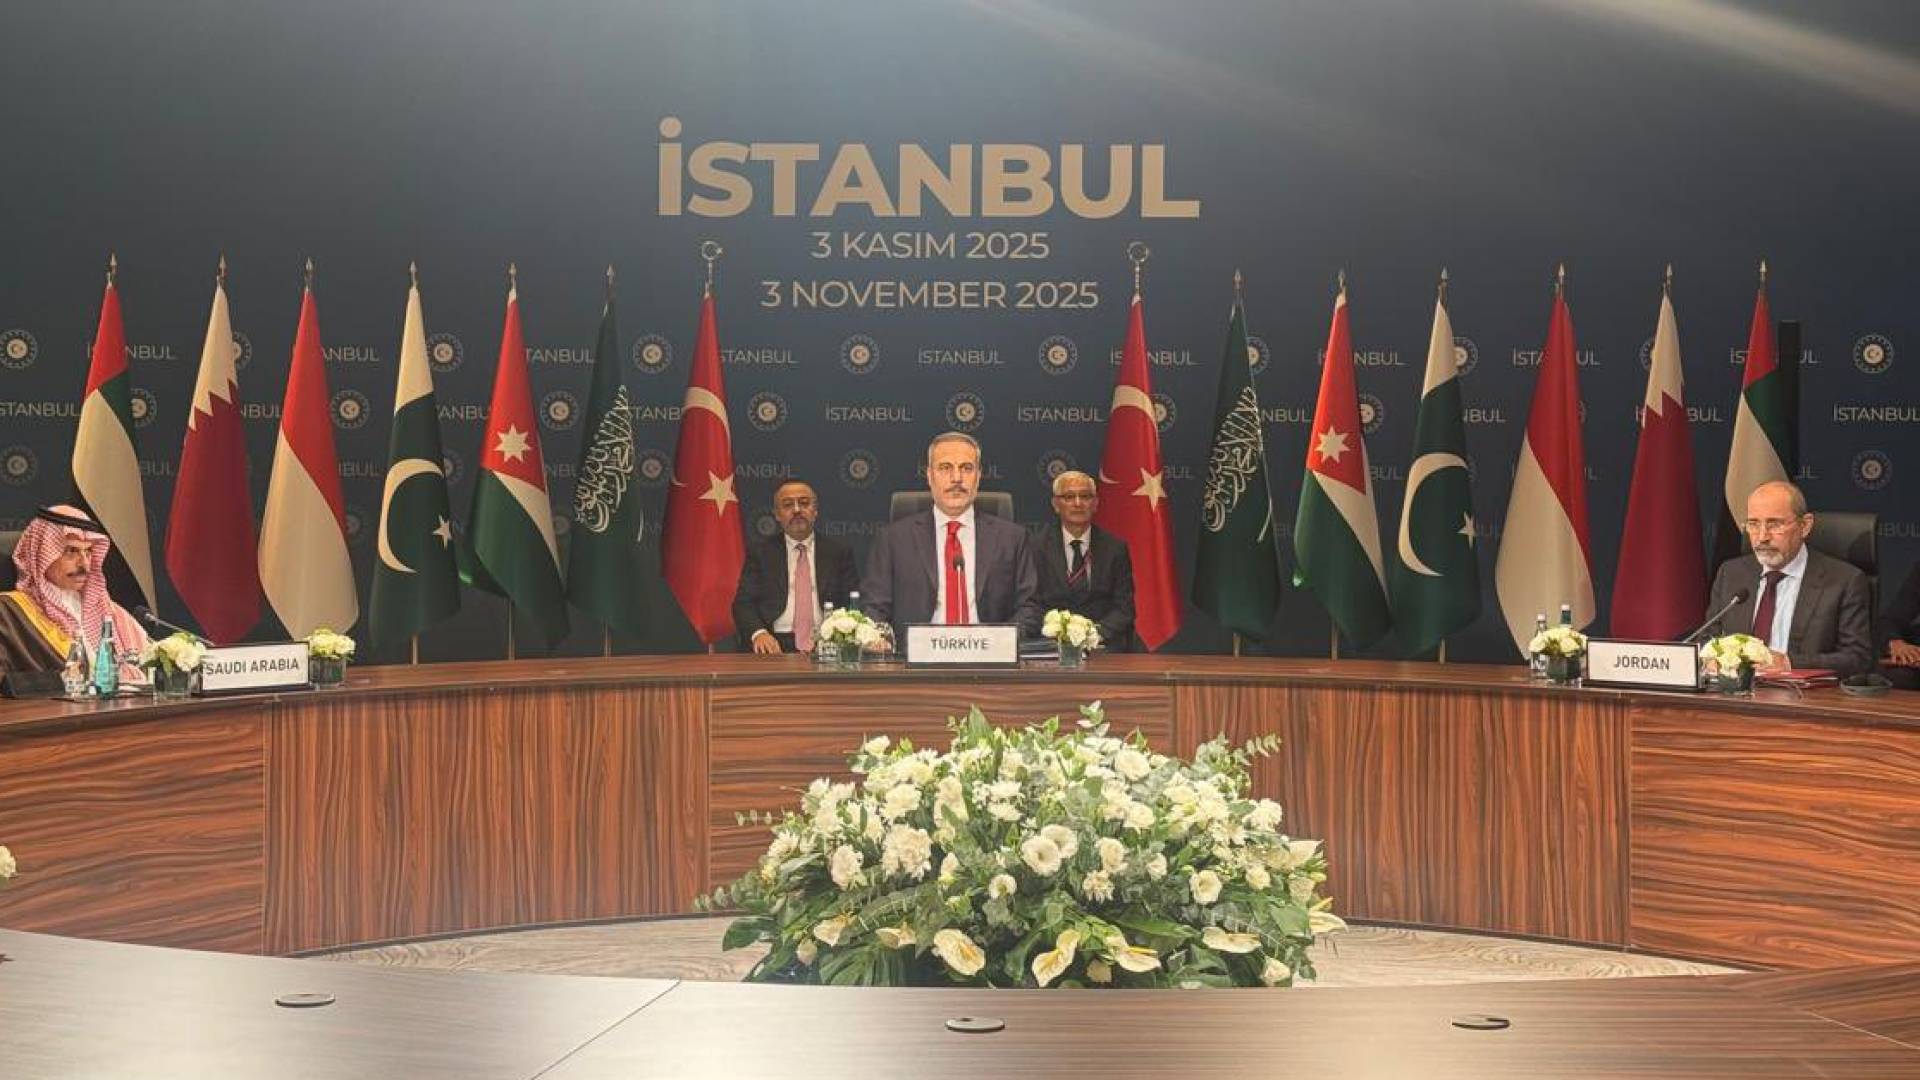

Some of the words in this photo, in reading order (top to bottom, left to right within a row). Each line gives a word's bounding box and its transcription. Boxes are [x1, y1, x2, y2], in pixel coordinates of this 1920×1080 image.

[657, 117, 1200, 219] İSTANBUL
[811, 231, 832, 260] 3
[843, 231, 959, 260] KASIM
[965, 231, 1051, 260] 2025
[761, 281, 782, 309] 3
[792, 281, 1007, 309] NOVEMBER
[1015, 281, 1100, 309] 2025
[917, 347, 1004, 364] İSTANBUL
[0, 401, 80, 417] STANBUL
[825, 404, 912, 421] İSTANBUL
[1017, 404, 1106, 422] İSTANBUL
[931, 635, 989, 650] TÜRKİYE
[205, 661, 246, 675] SAUDI
[250, 657, 299, 673] ARABIA
[1613, 655, 1670, 670] JORDAN
